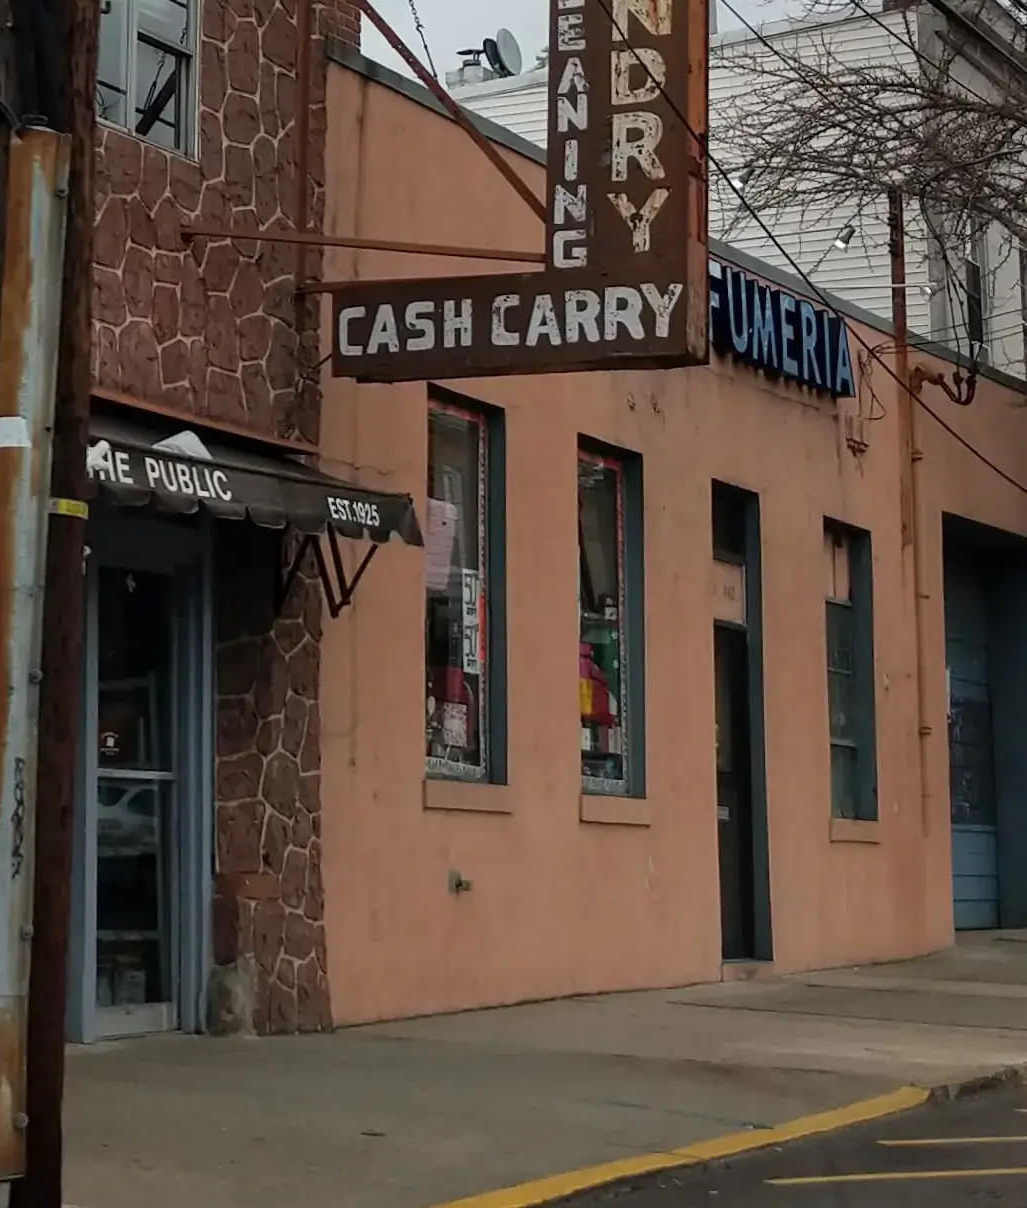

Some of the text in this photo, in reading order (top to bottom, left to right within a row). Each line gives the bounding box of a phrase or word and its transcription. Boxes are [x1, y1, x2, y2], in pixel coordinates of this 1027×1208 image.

[338, 283, 684, 356] CASH CARRY
[144, 456, 232, 502] PUBLIC
